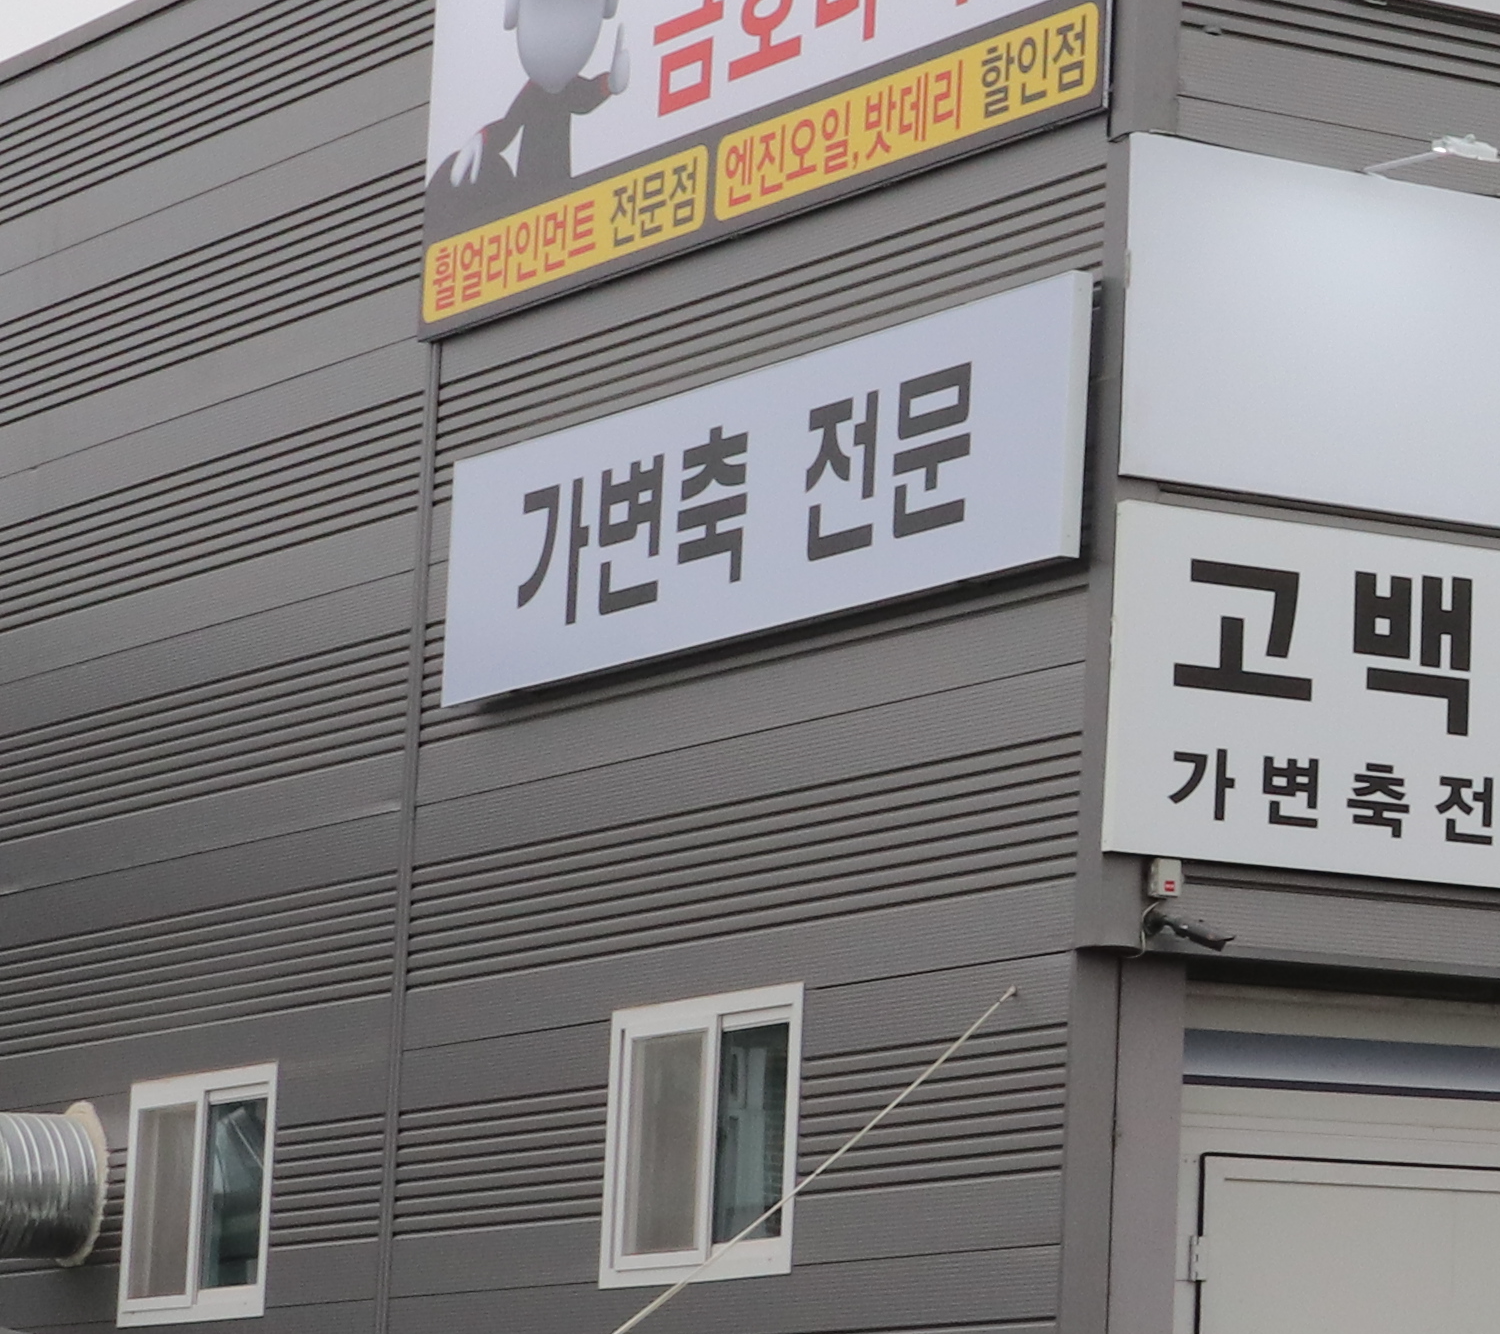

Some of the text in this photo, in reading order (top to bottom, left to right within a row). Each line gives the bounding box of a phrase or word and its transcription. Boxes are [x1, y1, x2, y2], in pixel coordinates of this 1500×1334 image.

[981, 16, 1088, 120] 할인점
[433, 156, 698, 312] 휠얼라인먼트 전문점
[517, 361, 972, 626] 가변축 전문
